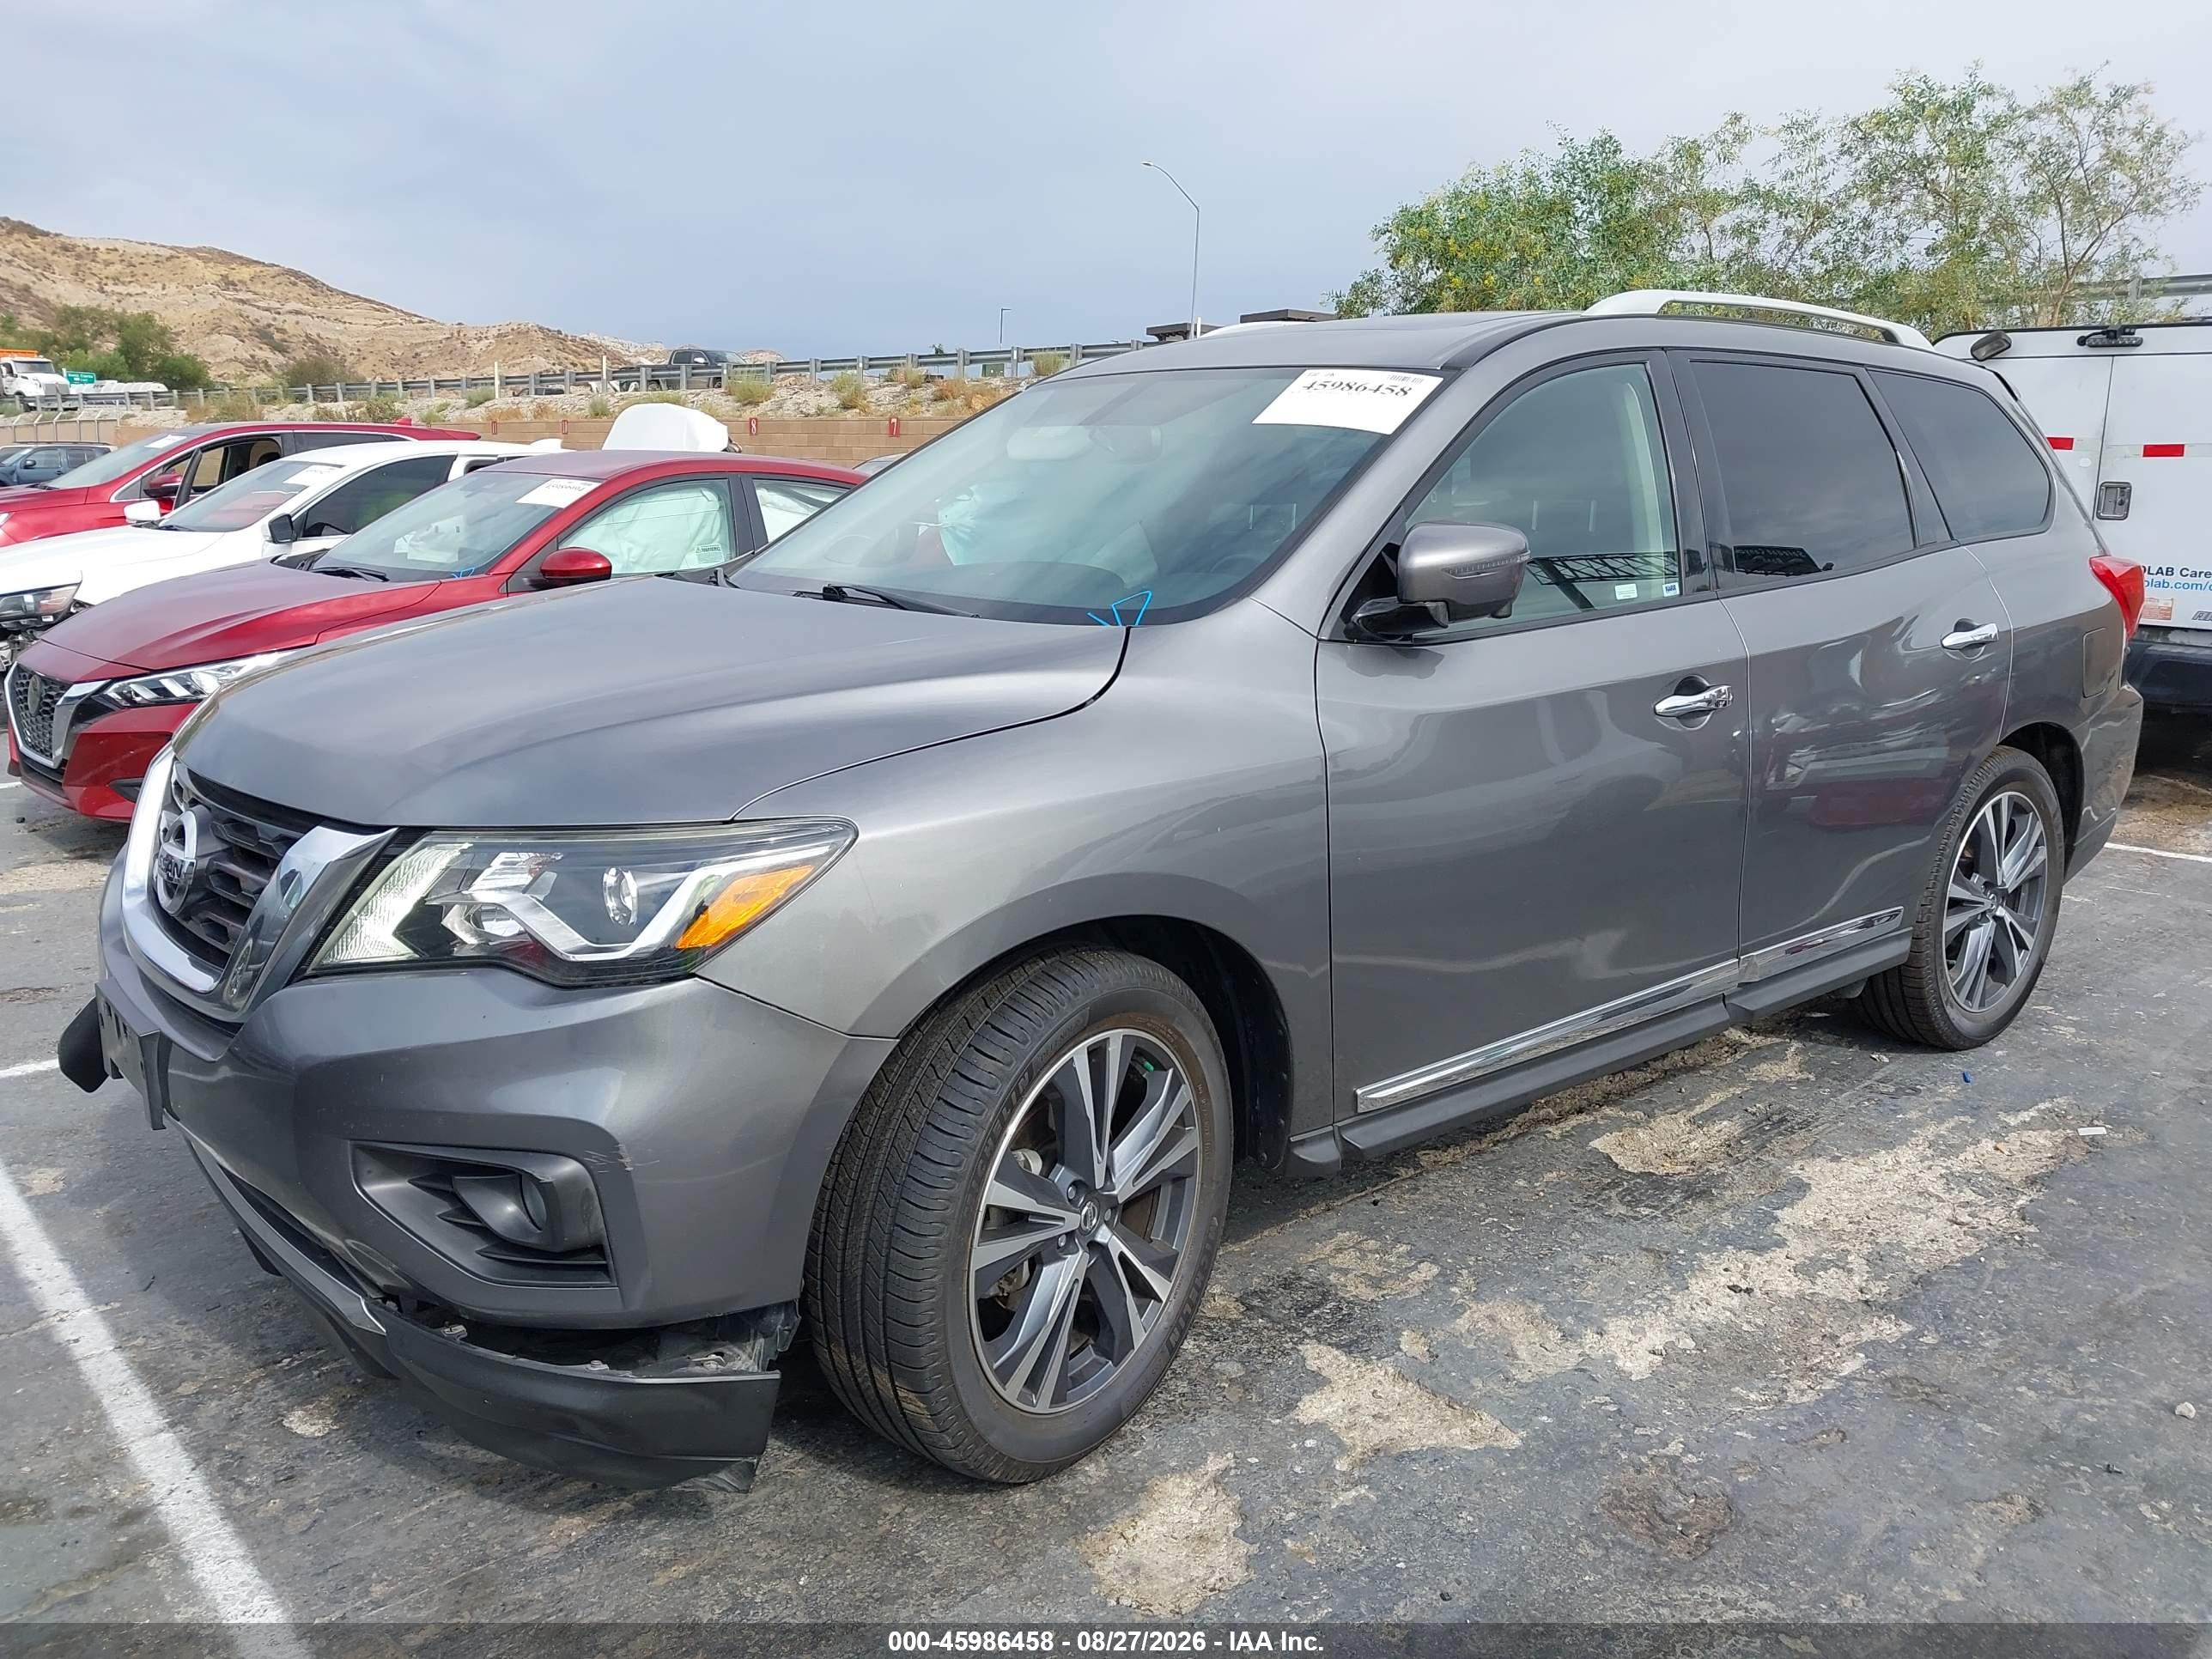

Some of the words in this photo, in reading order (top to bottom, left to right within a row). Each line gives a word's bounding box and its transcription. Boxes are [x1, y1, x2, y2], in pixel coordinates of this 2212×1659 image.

[1303, 380, 1412, 397] 45986458
[750, 418, 757, 434] 8
[890, 418, 897, 435] 7
